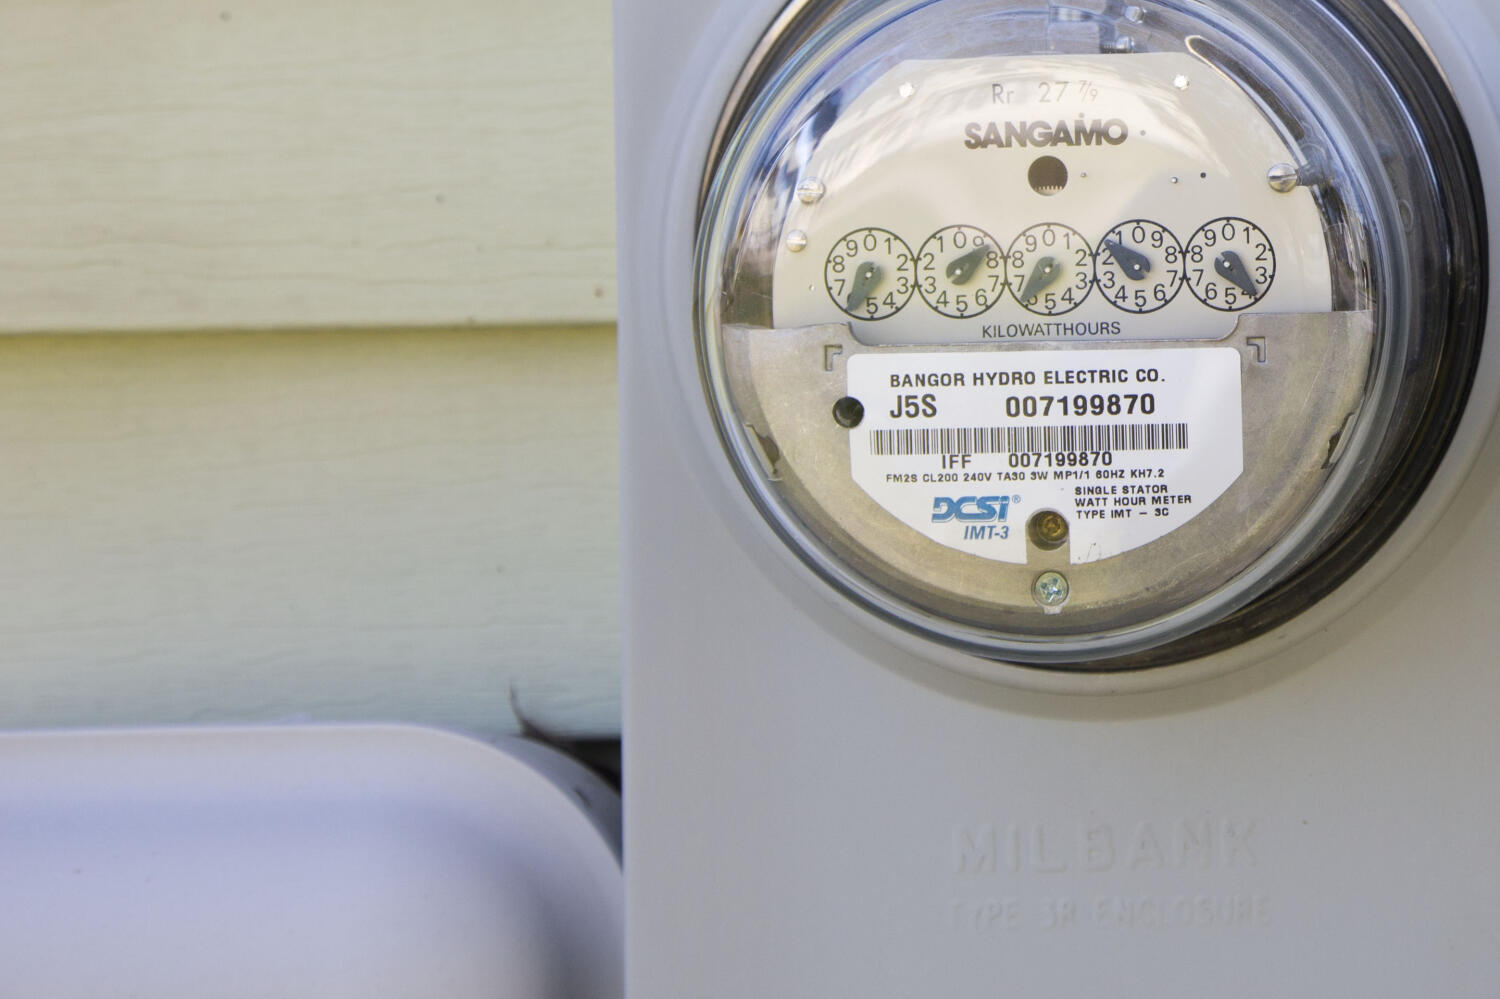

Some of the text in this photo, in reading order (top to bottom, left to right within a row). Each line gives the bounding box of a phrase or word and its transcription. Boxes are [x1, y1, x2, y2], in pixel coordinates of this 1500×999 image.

[963, 118, 1129, 150] SANGAMO
[981, 321, 1121, 339] KILOWATTHOURS
[890, 368, 1165, 387] BANGOR HYDRO ELECTRIC CO.
[889, 393, 1155, 418] J5S 007199870
[942, 451, 1112, 469] IFF 007199870
[885, 468, 1164, 483] FM2S CL200 240V TA30 3W MP1/1 60HZ KH7.2
[1074, 484, 1168, 495] SINGLE STATOR
[1074, 494, 1192, 507] WATT HOUR METER
[1076, 509, 1105, 519] TYPE
[1110, 508, 1132, 518] IMT
[1154, 507, 1169, 517] 3C
[963, 525, 1009, 540] IMT-3
